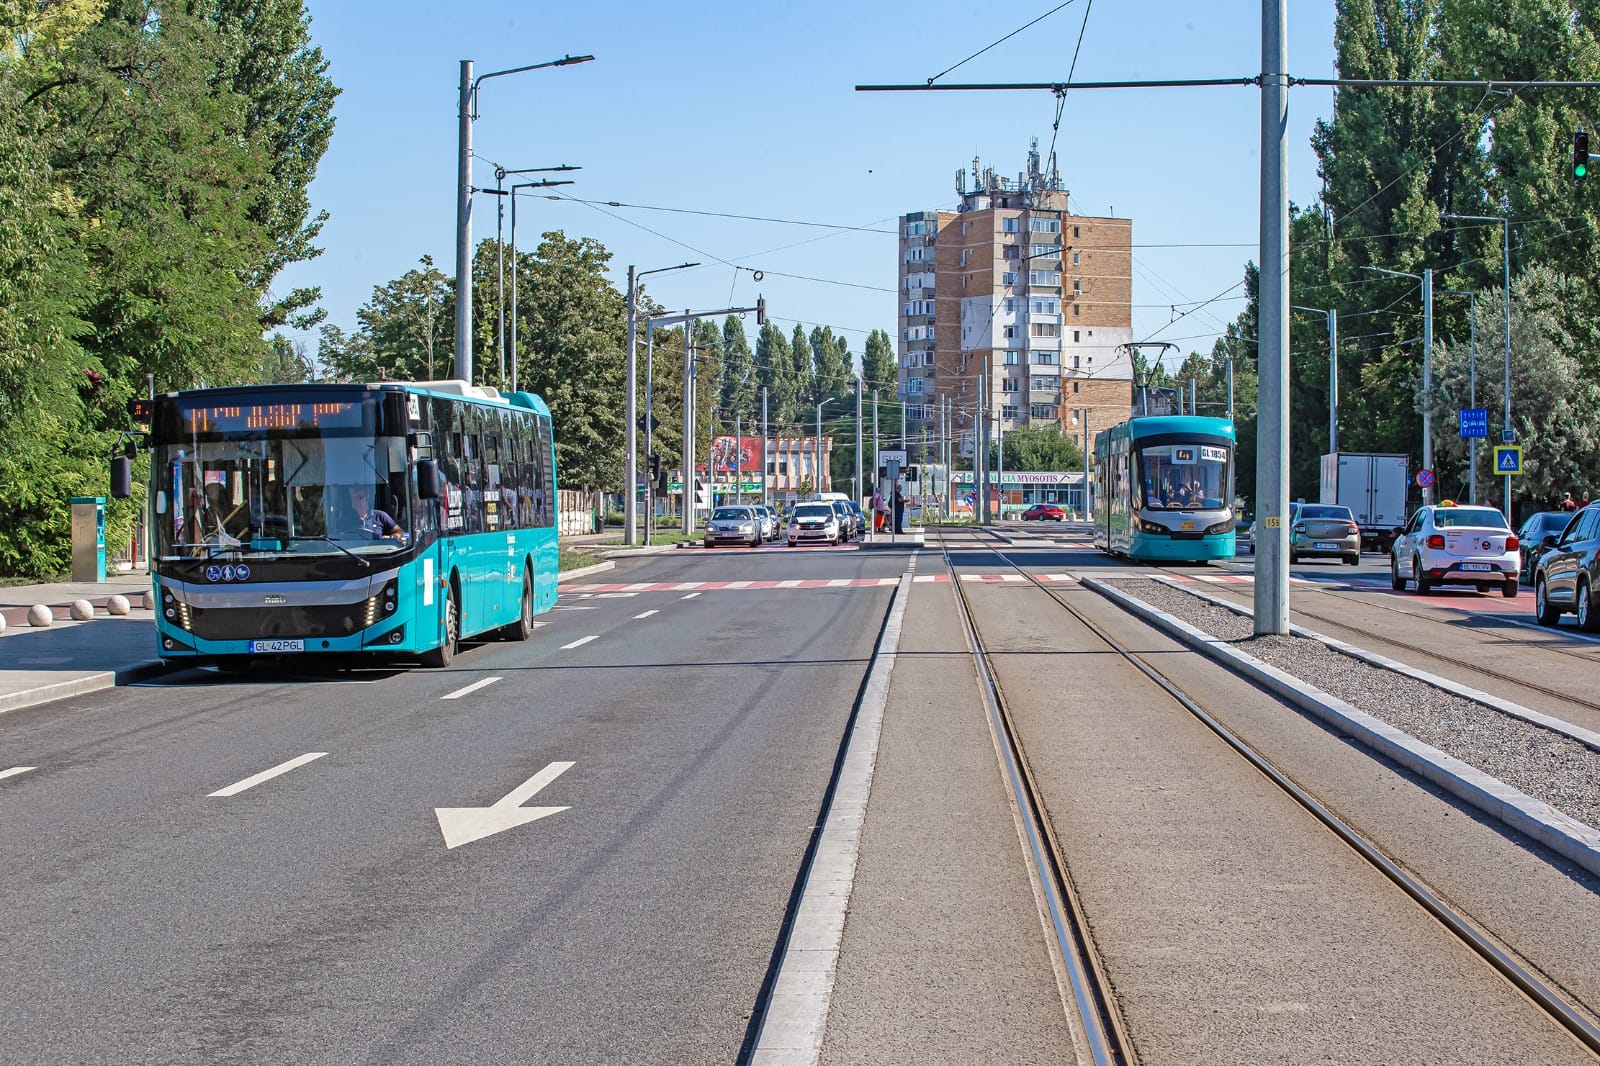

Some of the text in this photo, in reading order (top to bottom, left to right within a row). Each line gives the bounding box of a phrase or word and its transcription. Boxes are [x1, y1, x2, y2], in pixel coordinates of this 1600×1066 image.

[1202, 448, 1210, 458] GL
[1016, 474, 1058, 483] MYOSOTIS
[255, 642, 267, 651] GL
